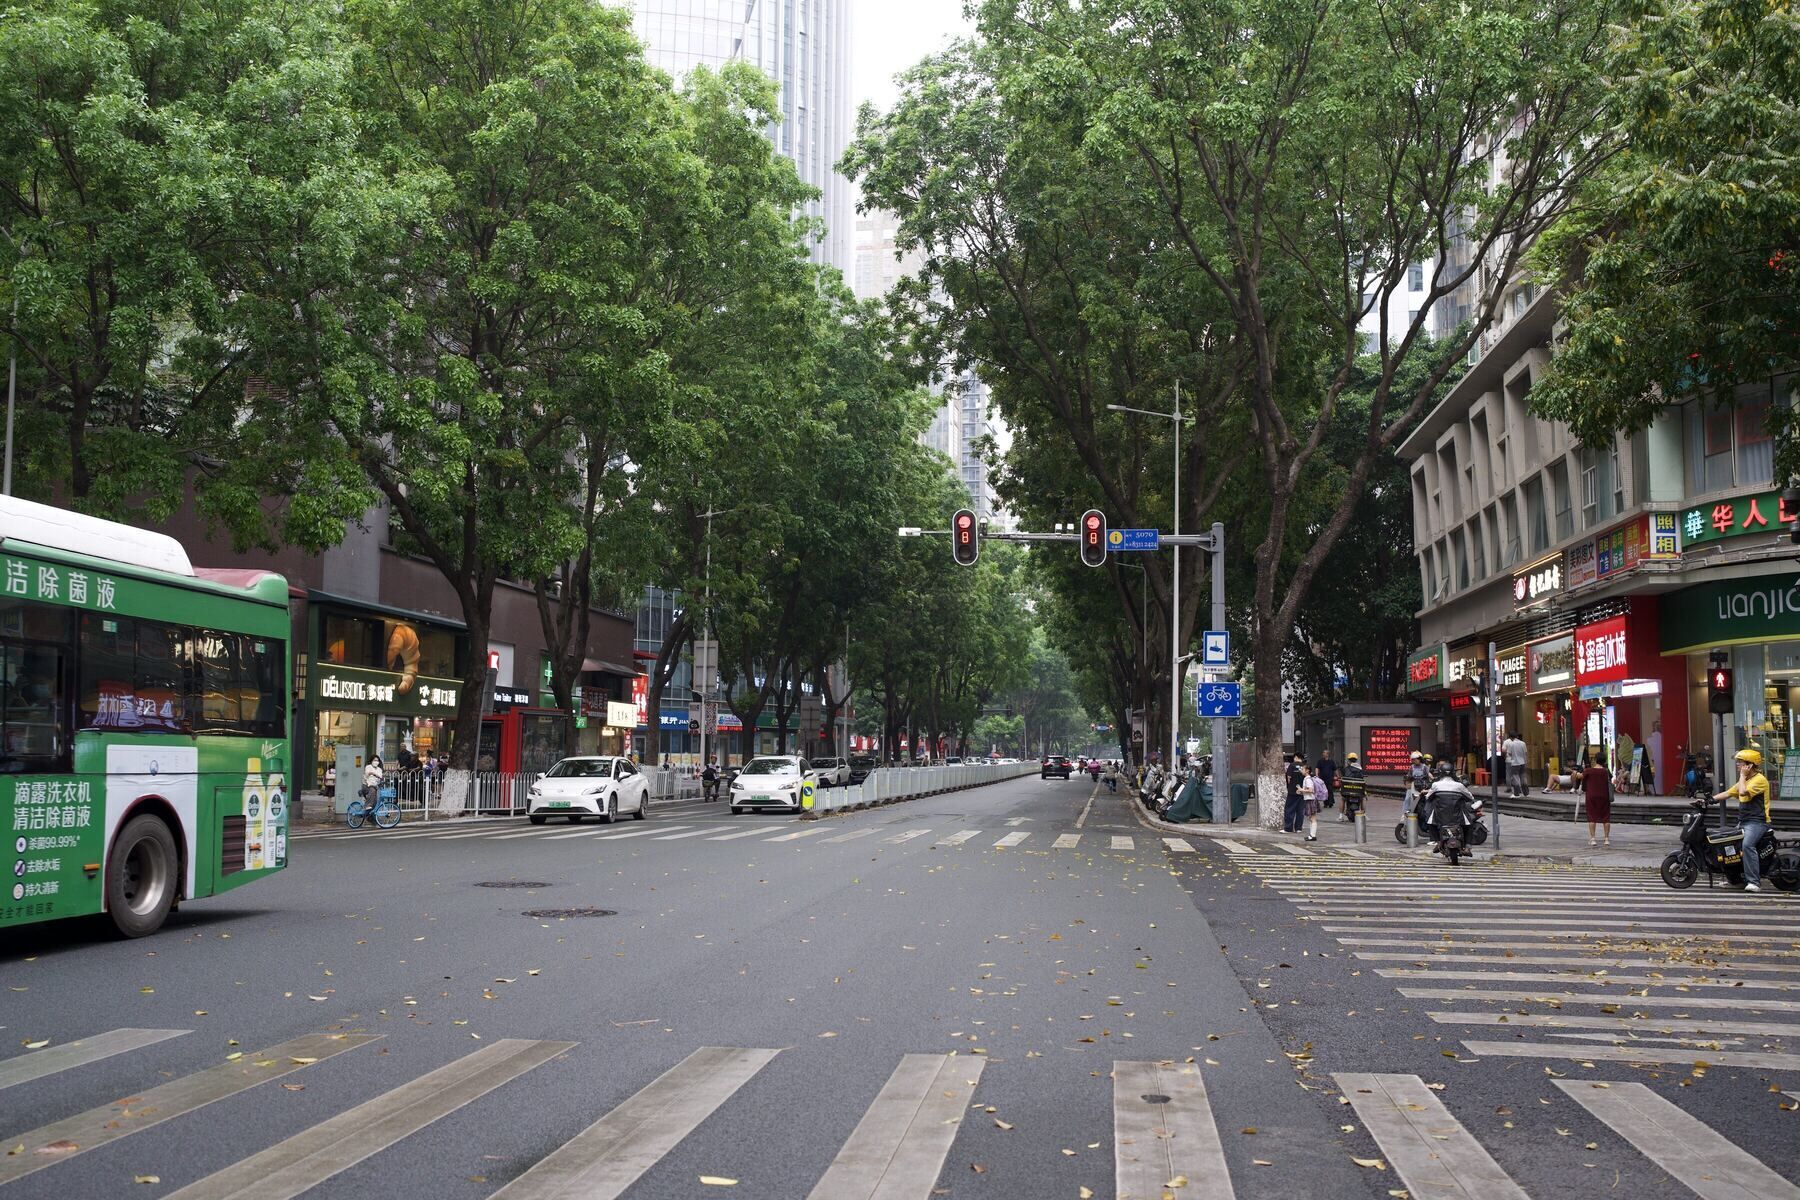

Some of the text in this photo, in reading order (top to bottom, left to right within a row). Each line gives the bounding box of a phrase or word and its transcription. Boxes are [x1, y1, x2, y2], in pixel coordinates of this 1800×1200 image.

[1657, 514, 1675, 552] 照相
[6, 559, 116, 610] 洁除菌液
[1501, 656, 1524, 672] CHAGEE
[1585, 631, 1627, 673] 蜜雪冰城
[14, 781, 91, 805] 滴露洗衣机
[13, 805, 91, 831] 清洁除菌液
[26, 858, 61, 873] 去除水垢
[24, 881, 59, 897] 持久清新
